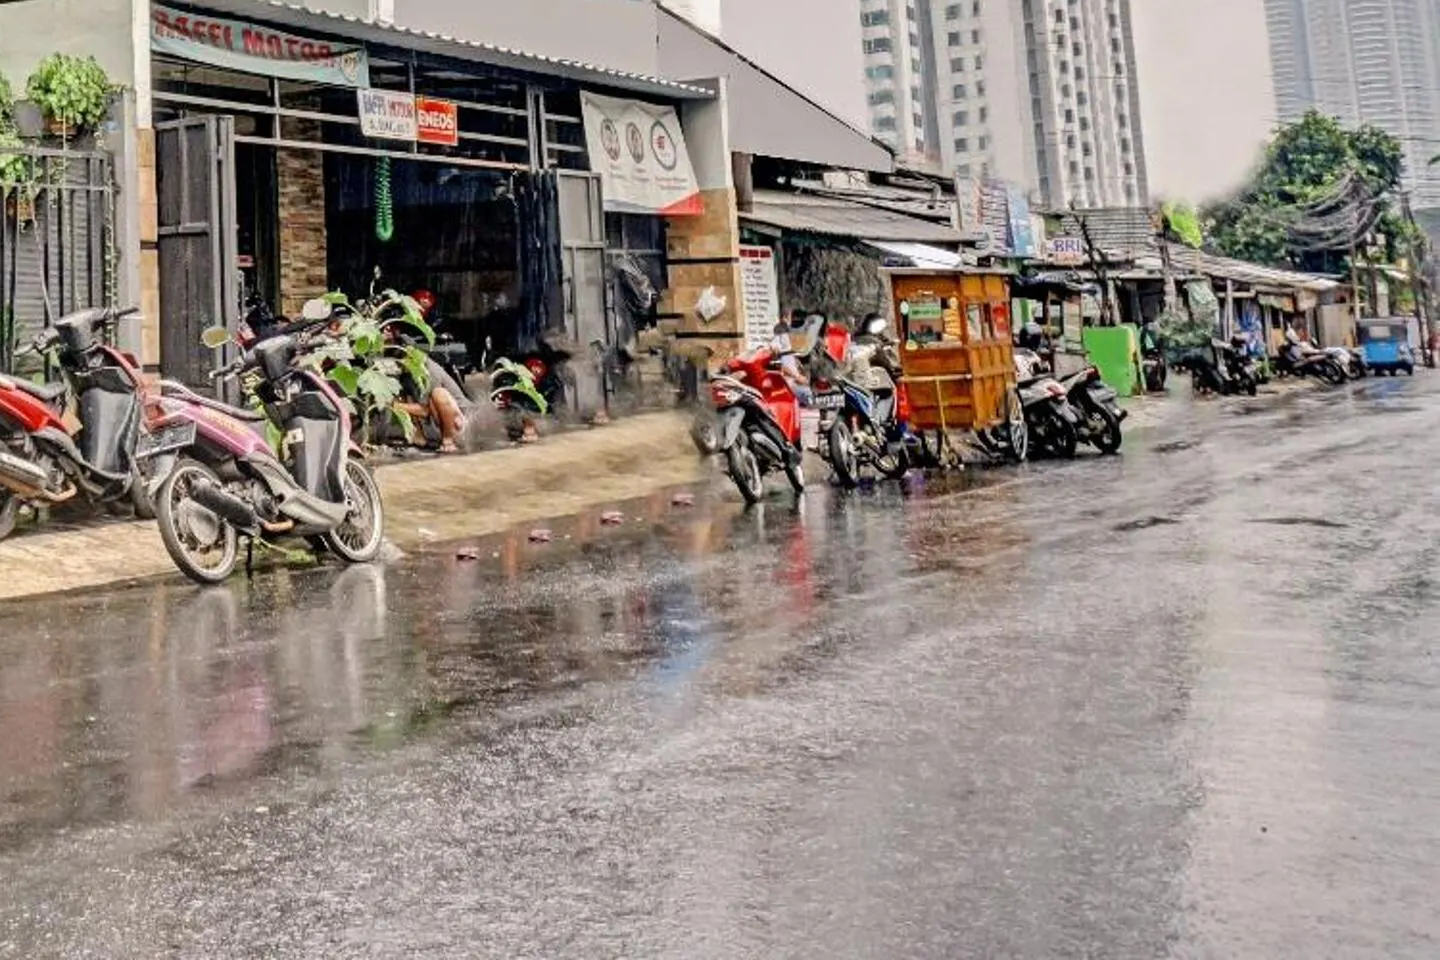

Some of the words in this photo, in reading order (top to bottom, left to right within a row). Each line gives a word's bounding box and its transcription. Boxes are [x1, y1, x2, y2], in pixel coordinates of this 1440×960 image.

[241, 25, 332, 62] MOTOR
[419, 110, 454, 129] ENEOS
[1053, 239, 1080, 252] BRI
